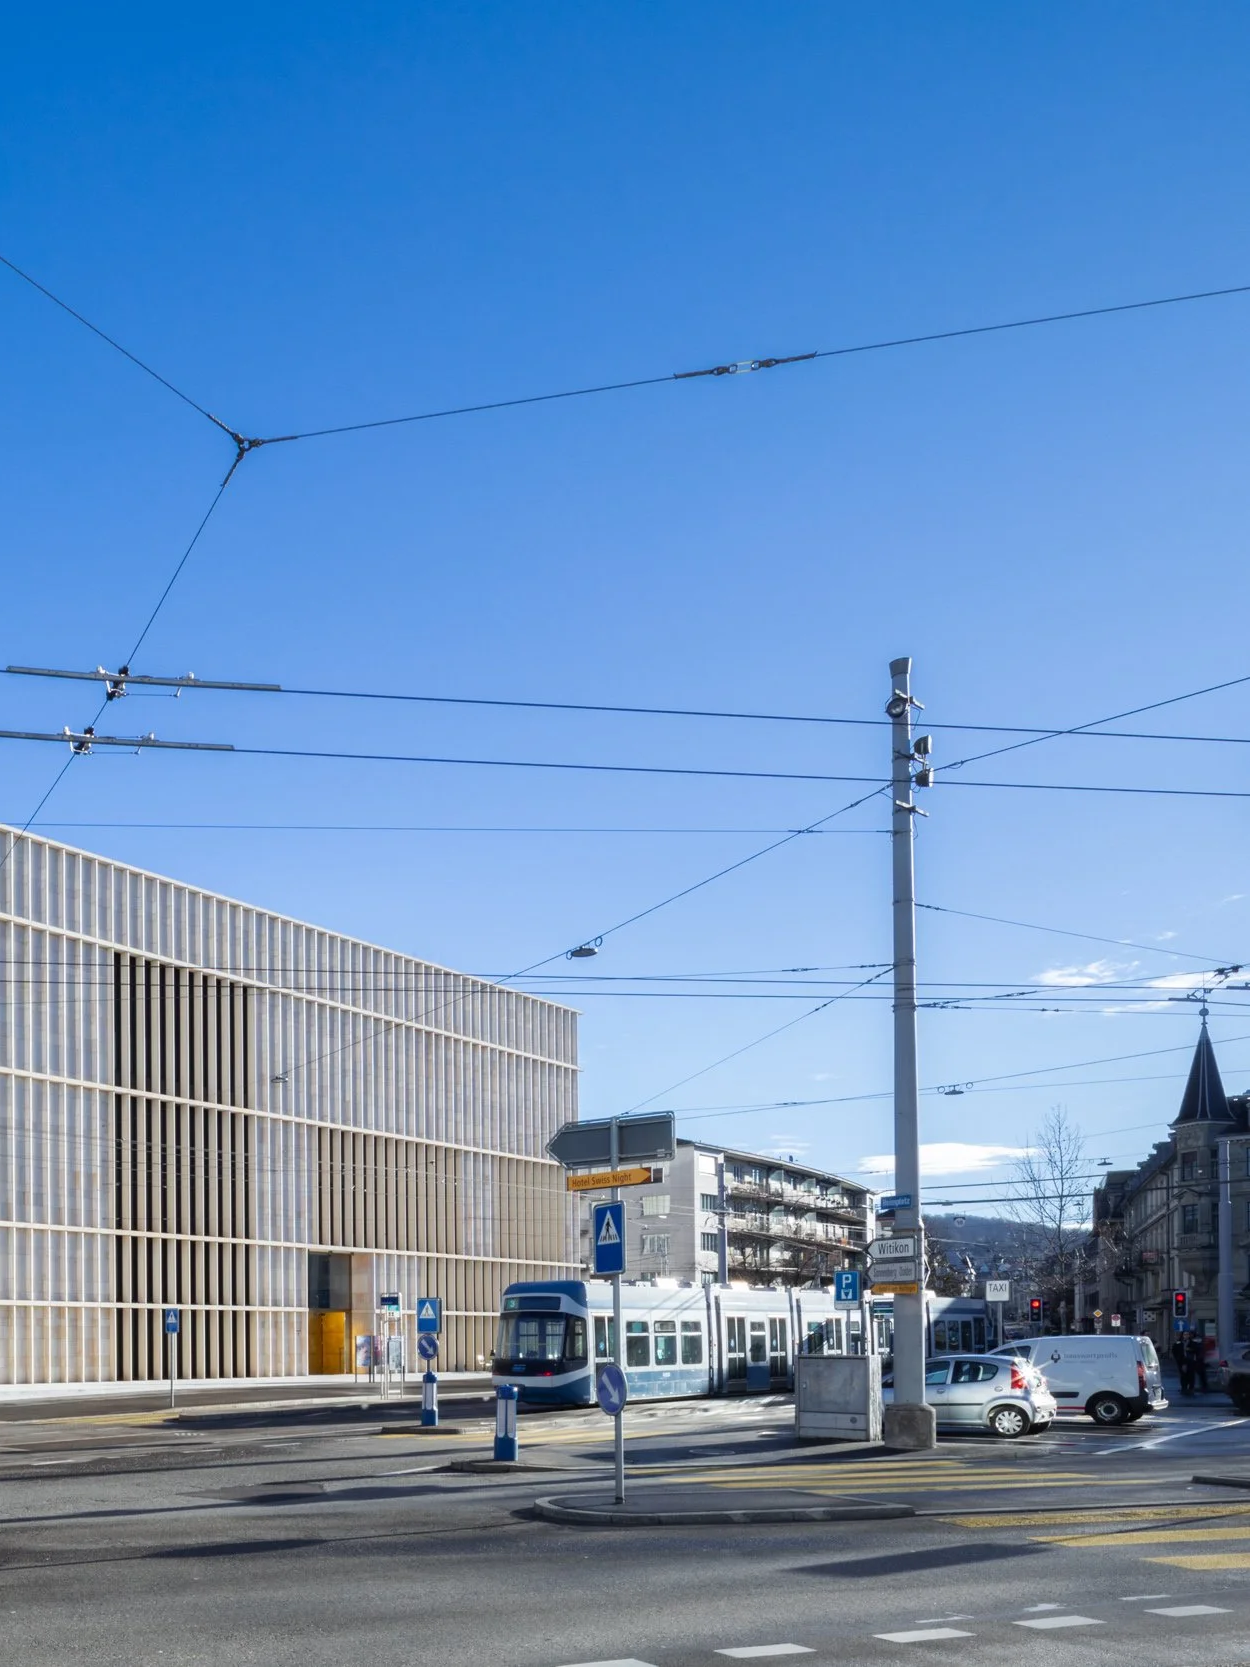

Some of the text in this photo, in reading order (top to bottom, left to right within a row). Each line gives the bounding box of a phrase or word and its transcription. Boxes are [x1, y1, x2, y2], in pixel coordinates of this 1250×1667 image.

[572, 1173, 632, 1187] Hotel Swiss Night
[878, 1241, 909, 1254] Witikon
[842, 1274, 852, 1288] P
[988, 1283, 1007, 1292] TAXI
